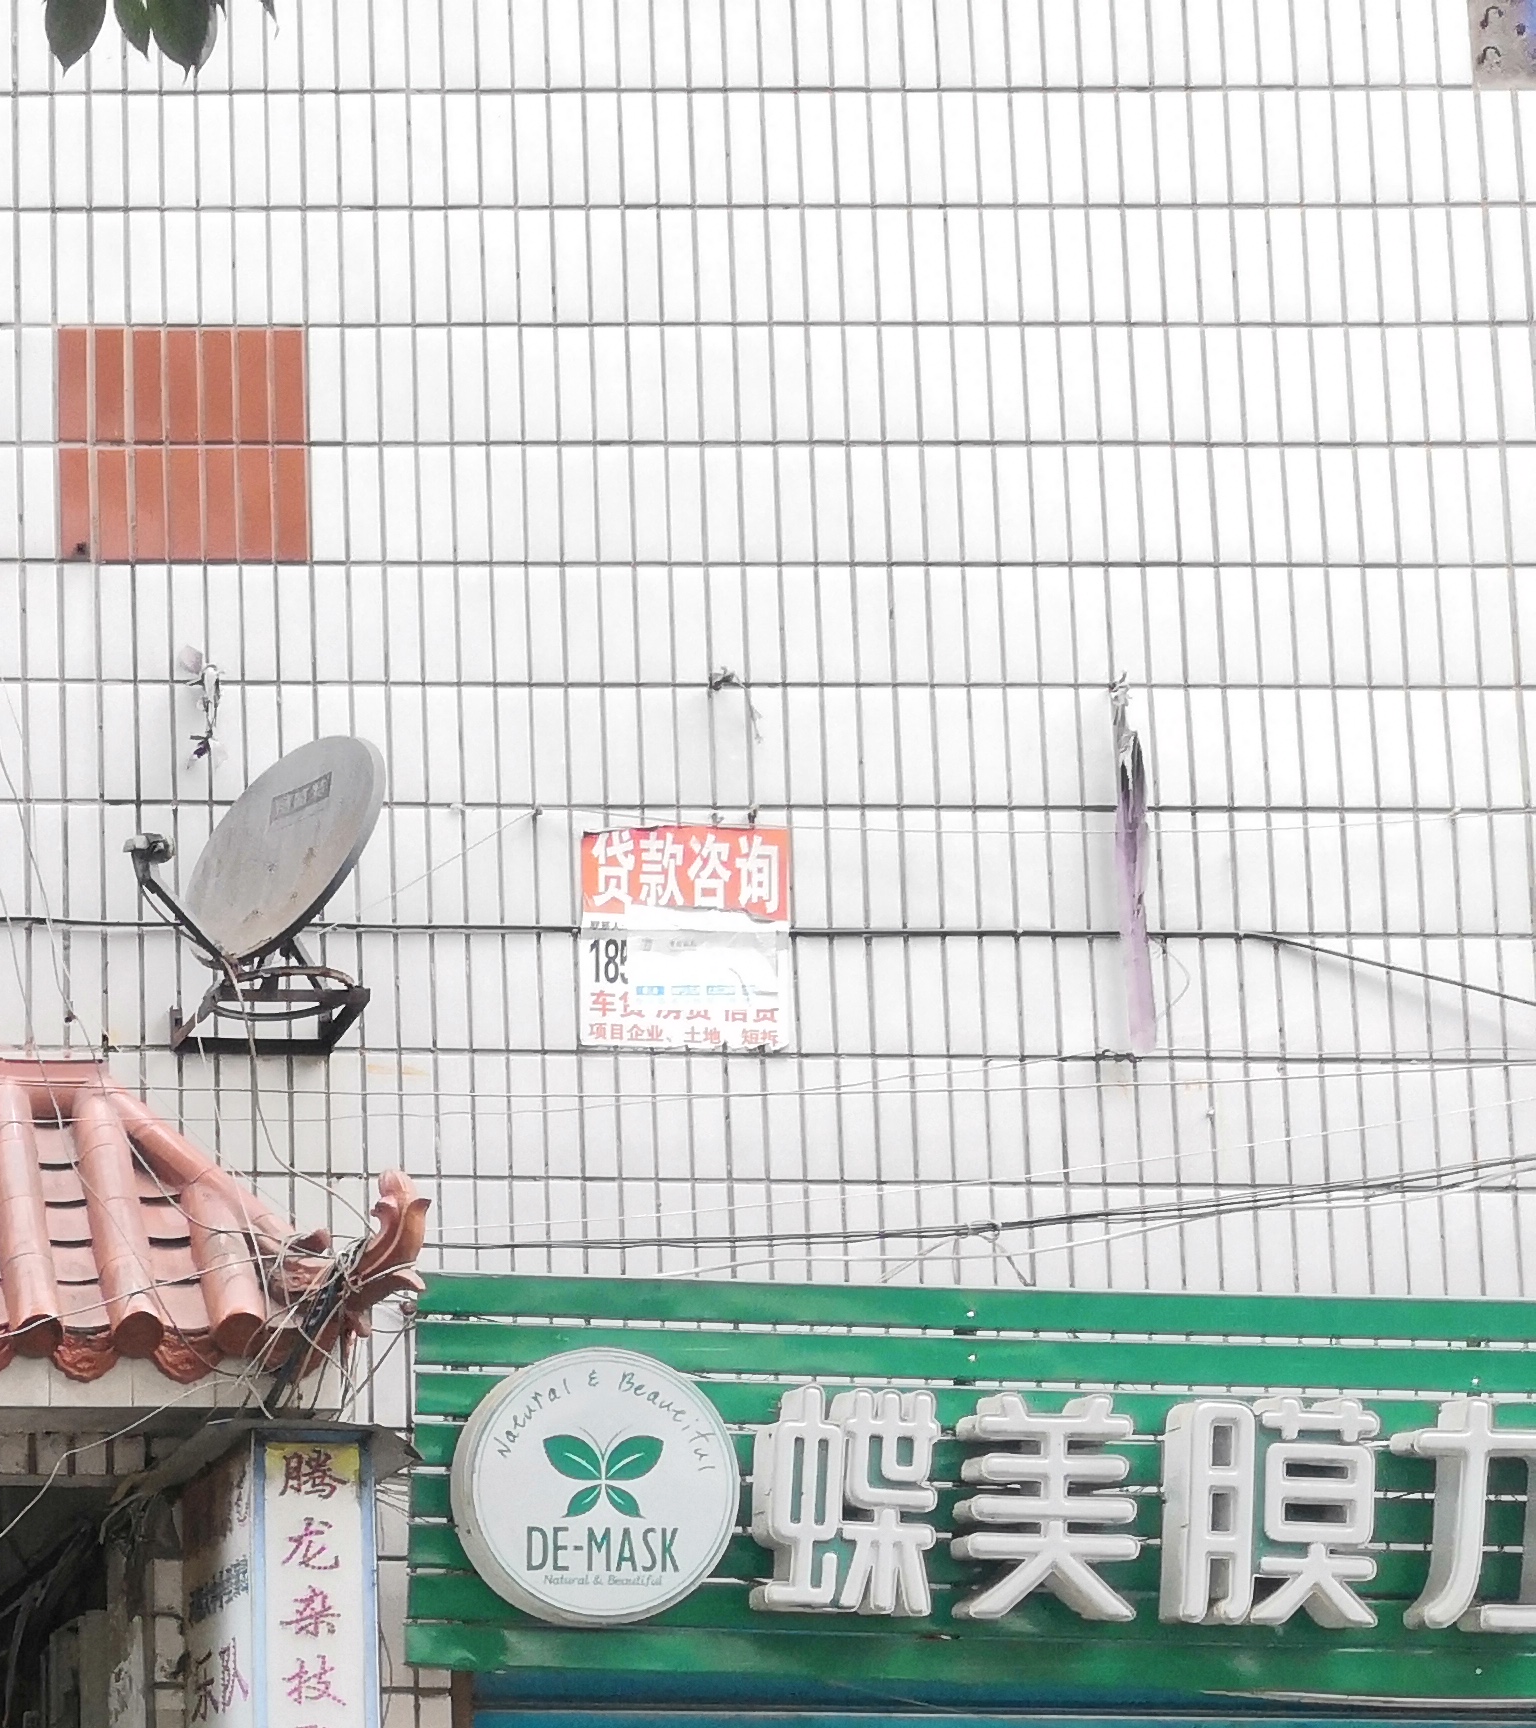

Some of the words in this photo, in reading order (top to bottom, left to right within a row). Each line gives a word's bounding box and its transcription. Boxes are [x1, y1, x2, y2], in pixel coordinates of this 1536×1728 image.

[591, 830, 780, 914] 贷款咨询
[526, 1526, 680, 1573] DE-MASK
